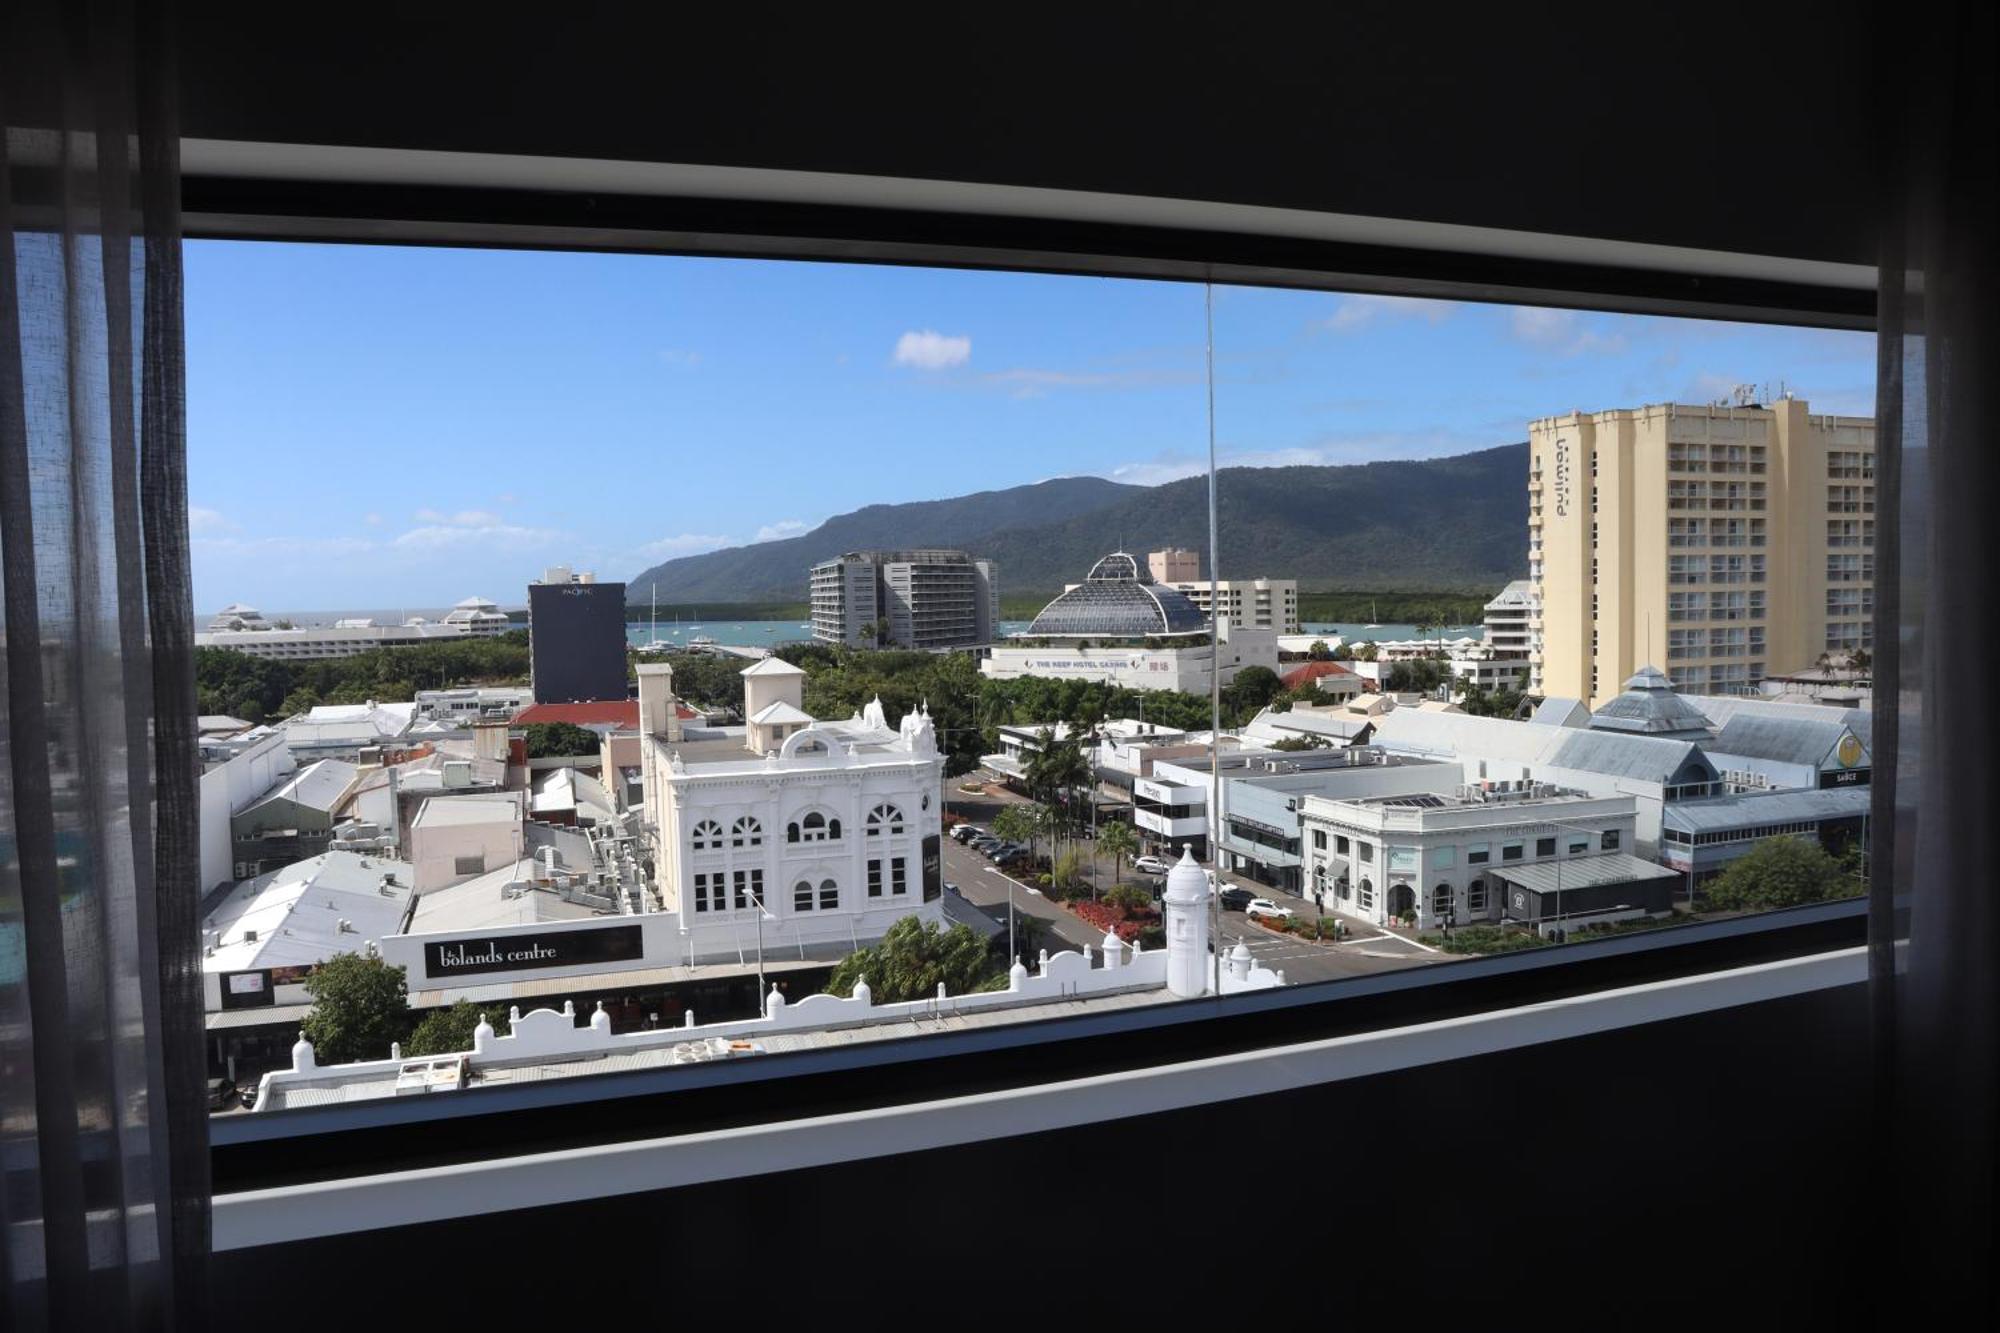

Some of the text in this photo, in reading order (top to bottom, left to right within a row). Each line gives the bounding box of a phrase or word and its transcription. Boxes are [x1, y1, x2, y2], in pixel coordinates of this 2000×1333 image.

[1554, 438, 1567, 516] pullman
[439, 941, 557, 967] bolands centre
